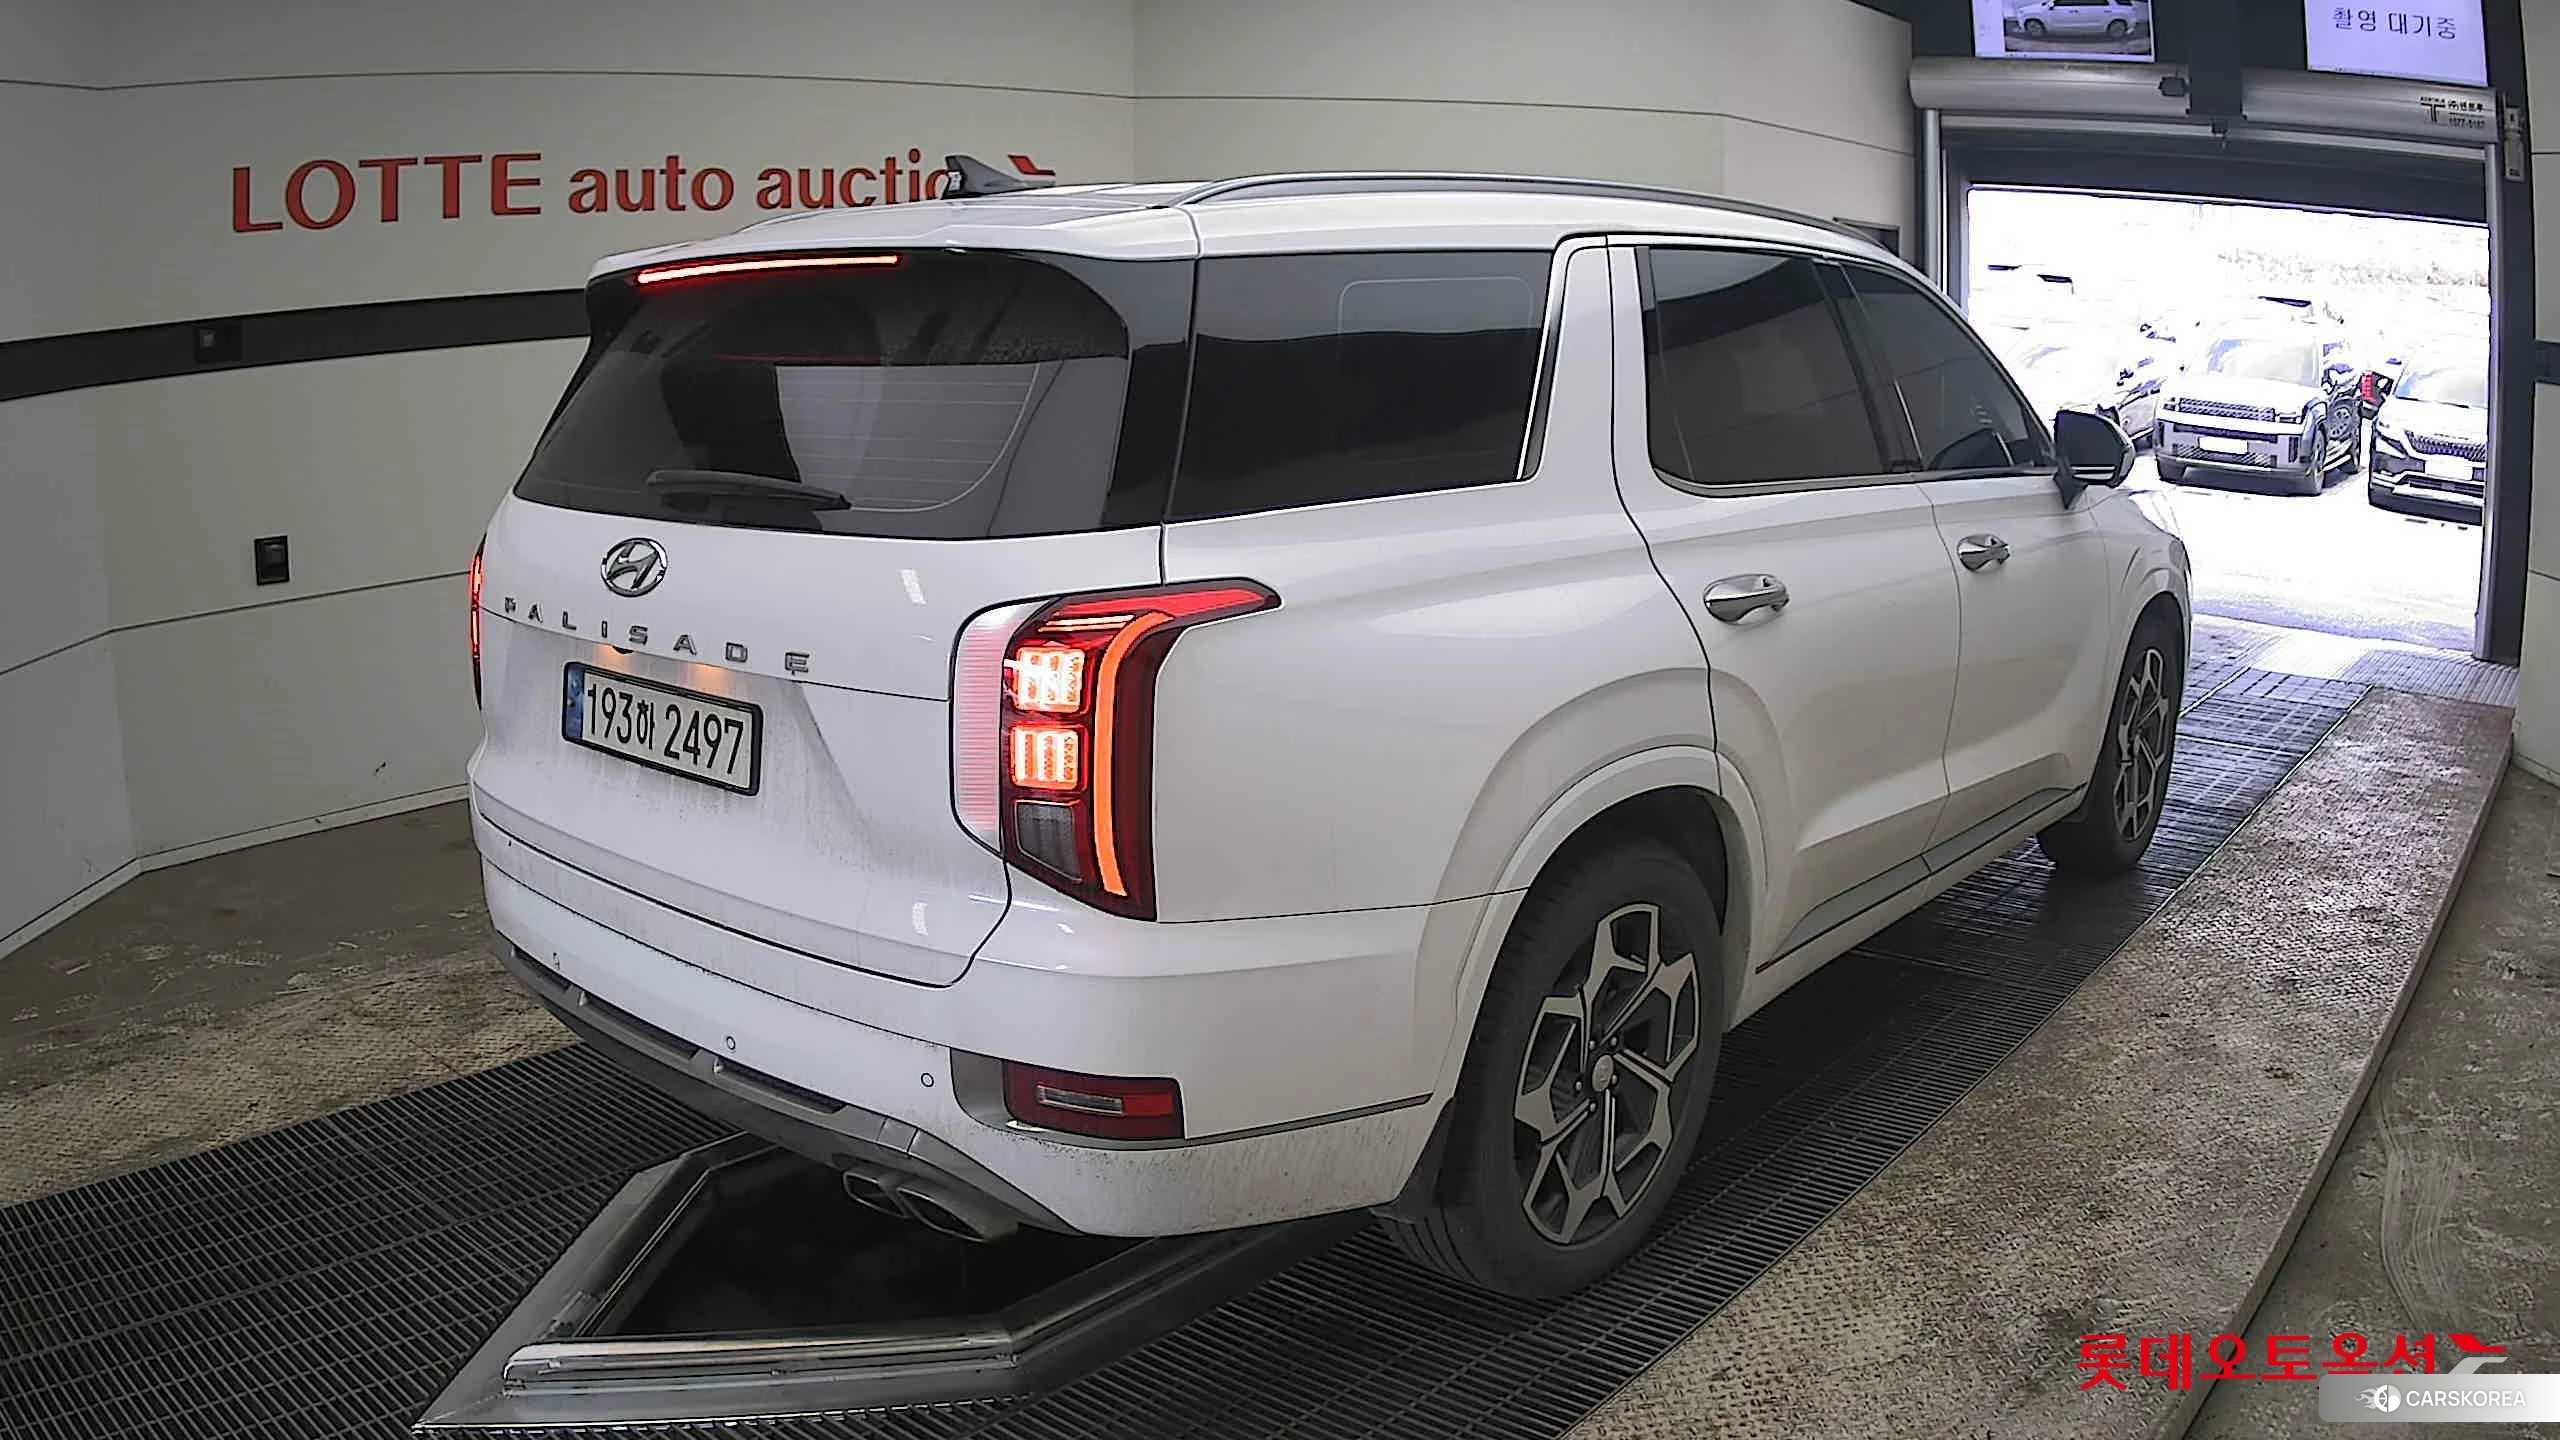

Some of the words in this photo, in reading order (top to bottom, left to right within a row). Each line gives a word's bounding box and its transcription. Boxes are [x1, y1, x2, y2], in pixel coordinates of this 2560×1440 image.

[2388, 12, 2457, 40] 대기중
[232, 153, 542, 233] LOTTE
[568, 155, 735, 214] auto
[504, 597, 810, 675] PALISADE
[587, 683, 655, 750] 193하
[663, 703, 745, 775] 2497
